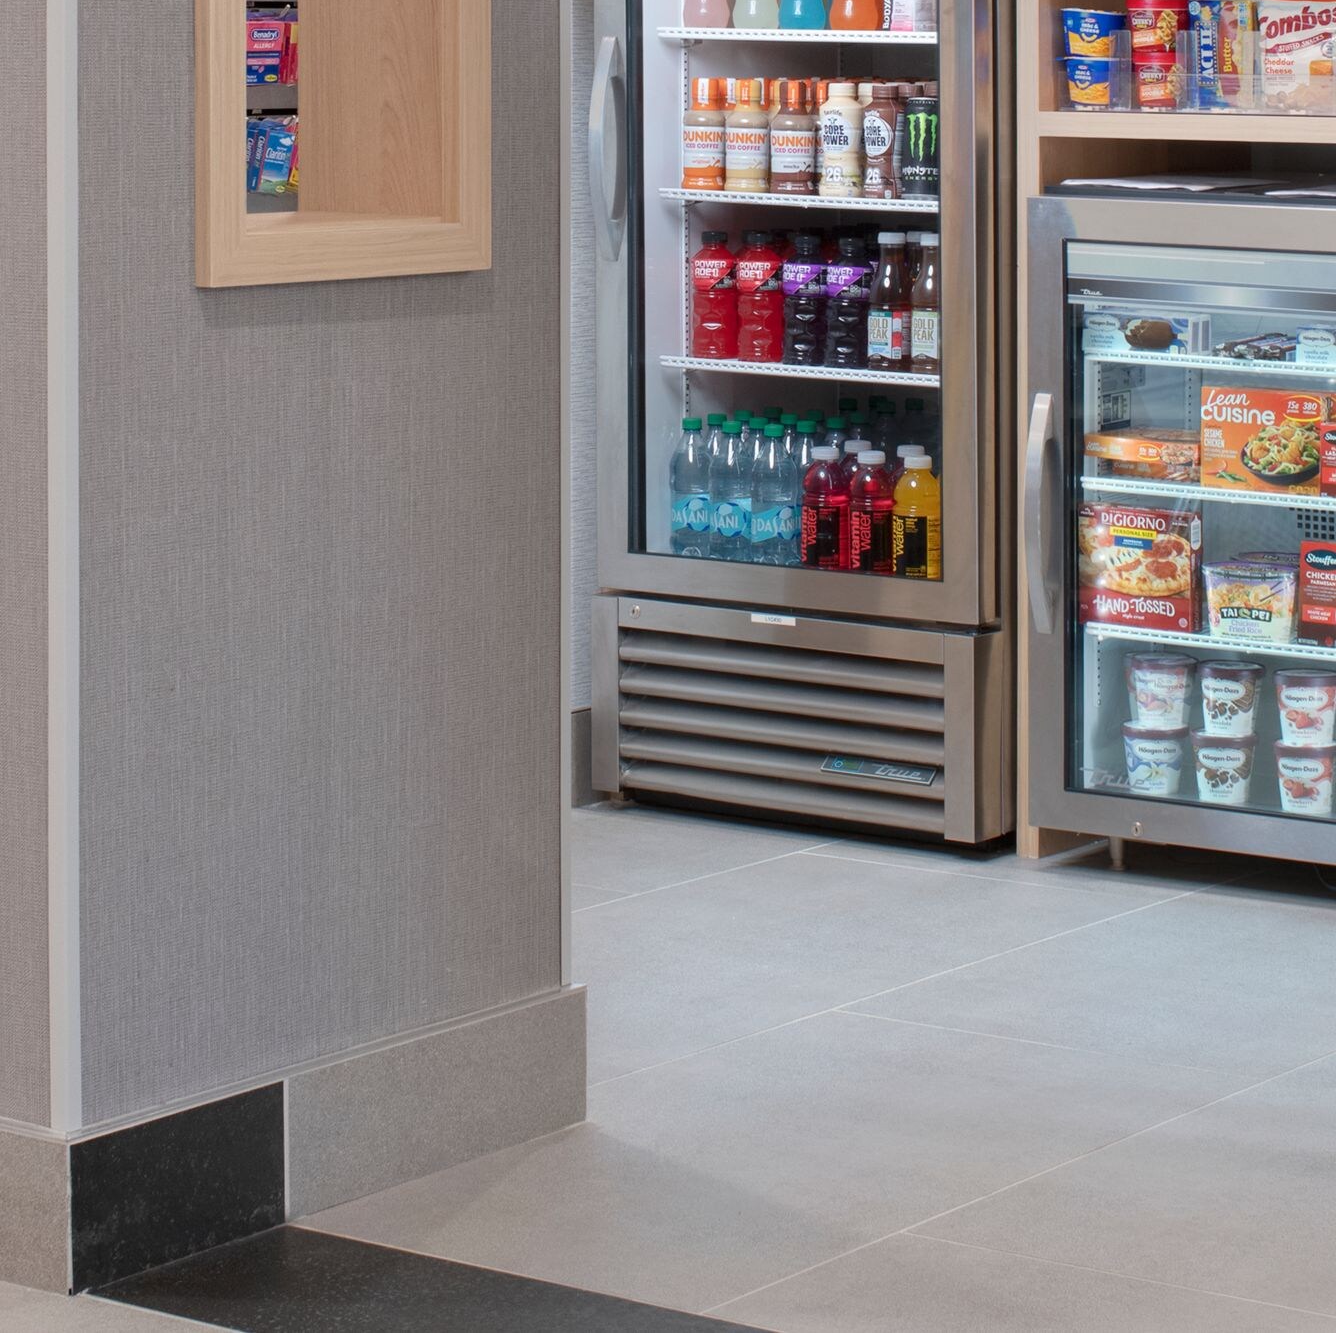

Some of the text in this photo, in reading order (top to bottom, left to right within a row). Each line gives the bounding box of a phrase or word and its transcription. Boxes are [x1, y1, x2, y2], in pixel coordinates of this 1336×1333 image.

[253, 30, 278, 40] Benadryl
[1223, 37, 1232, 72] Butter
[1200, 48, 1214, 80] ACT
[1264, 57, 1294, 66] Cheddar
[1265, 66, 1293, 75] Cheese
[825, 125, 845, 136] CORE
[266, 147, 287, 161] Claritin
[902, 165, 938, 176] MONSTE
[695, 260, 727, 269] POWER
[740, 262, 771, 271] POWER
[914, 318, 934, 329] GOLD
[914, 329, 934, 341] PEAK
[1206, 389, 1251, 407] Lean
[1302, 401, 1318, 411] 380
[807, 508, 817, 545] water
[1101, 512, 1166, 531] DIGIORNO
[861, 512, 871, 551] water
[895, 517, 905, 556] water
[851, 511, 860, 569] vitamin
[1093, 594, 1176, 618] HAND-TOSSED
[1221, 608, 1270, 621] TAI PEI
